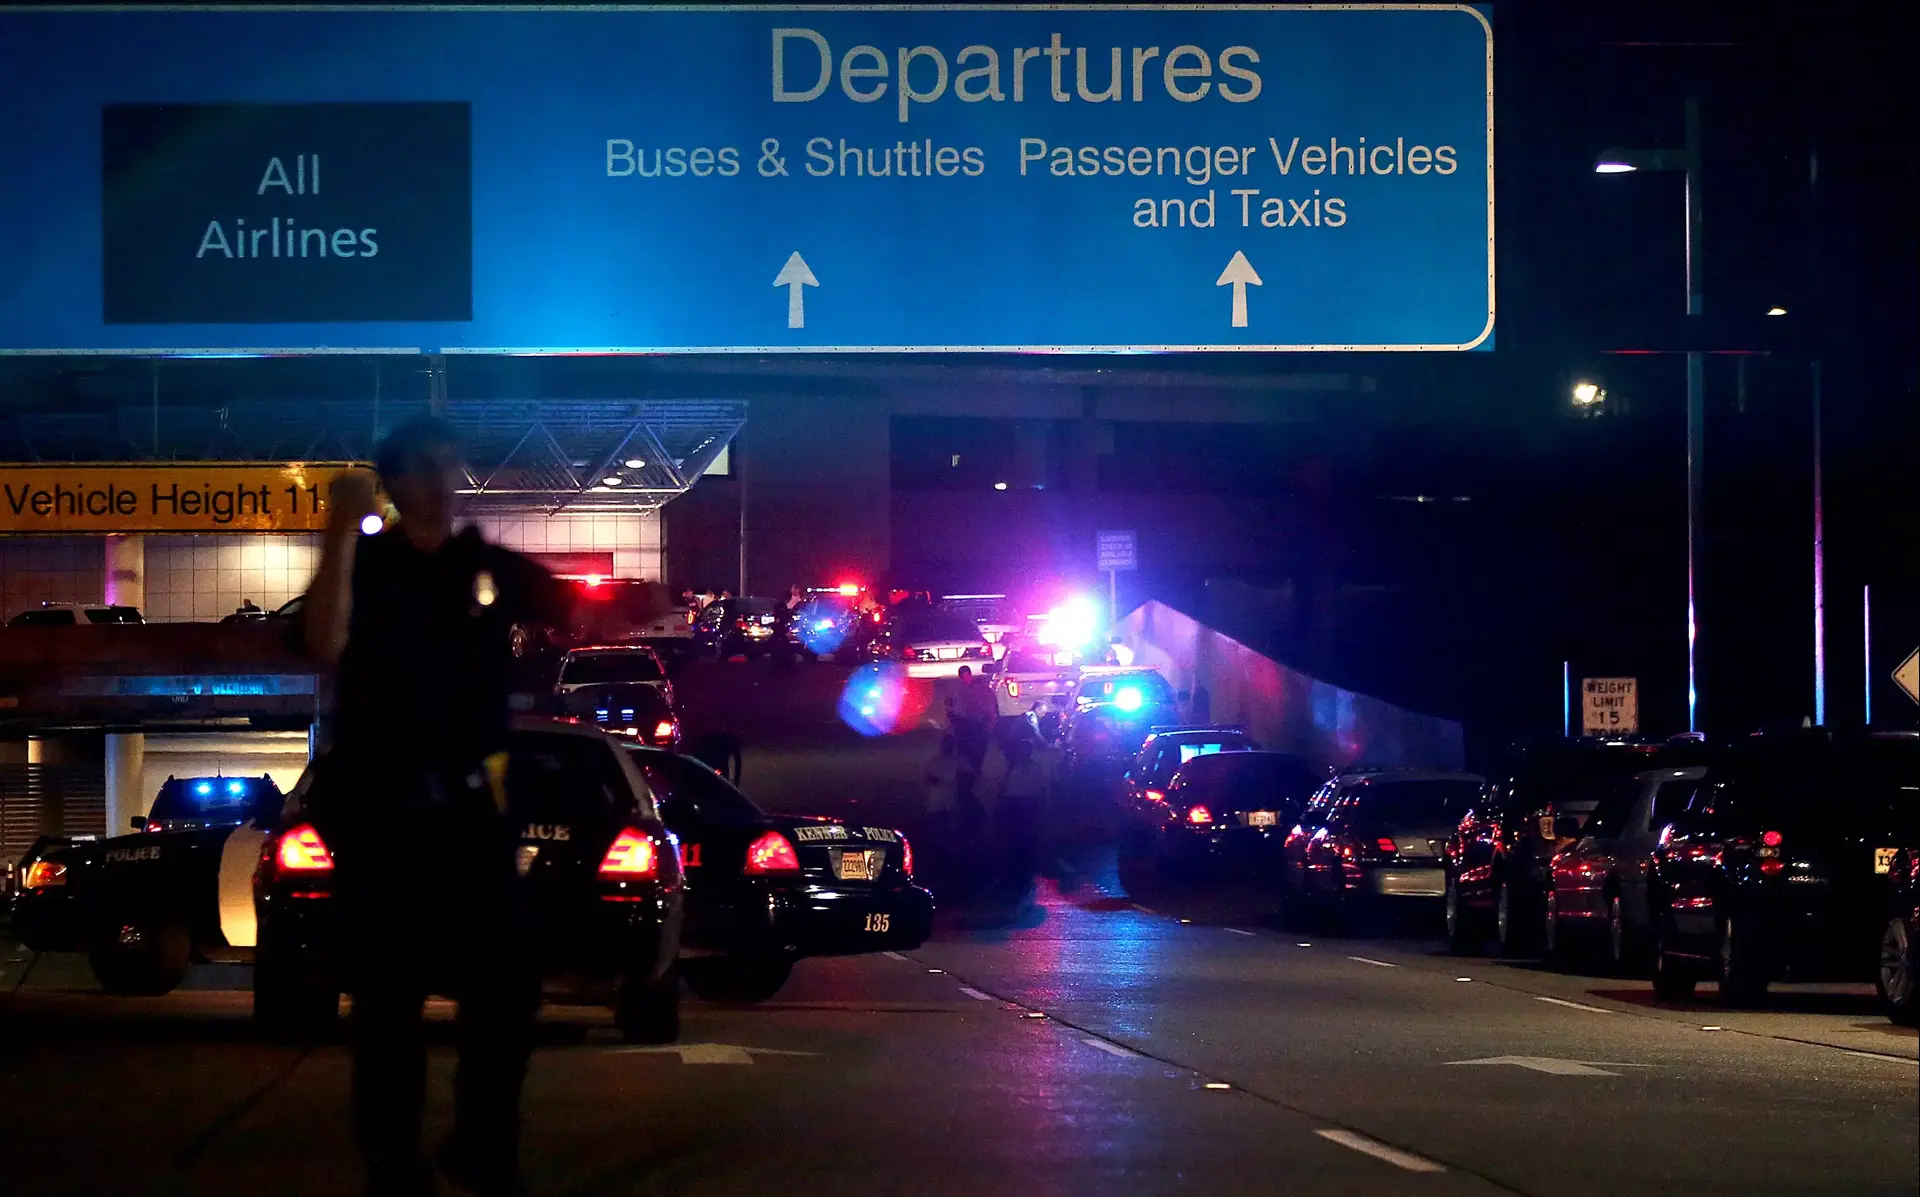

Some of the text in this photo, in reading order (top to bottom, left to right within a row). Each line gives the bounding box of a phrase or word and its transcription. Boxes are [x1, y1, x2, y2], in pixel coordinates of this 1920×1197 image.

[772, 28, 1262, 123] Departures
[257, 153, 321, 196] All
[607, 137, 985, 177] Buses & Shuttles
[1020, 136, 1458, 186] Passenger Vehicles
[1133, 188, 1347, 228] and Taxis
[196, 216, 380, 259] Airlines
[4, 482, 138, 516] Vehicle
[150, 482, 271, 523] Height
[1587, 682, 1632, 694] WEIGHT
[1593, 696, 1625, 708] LIMIT
[105, 845, 162, 863] POLICE
[862, 826, 898, 843] POLICE
[864, 912, 890, 933] 135
